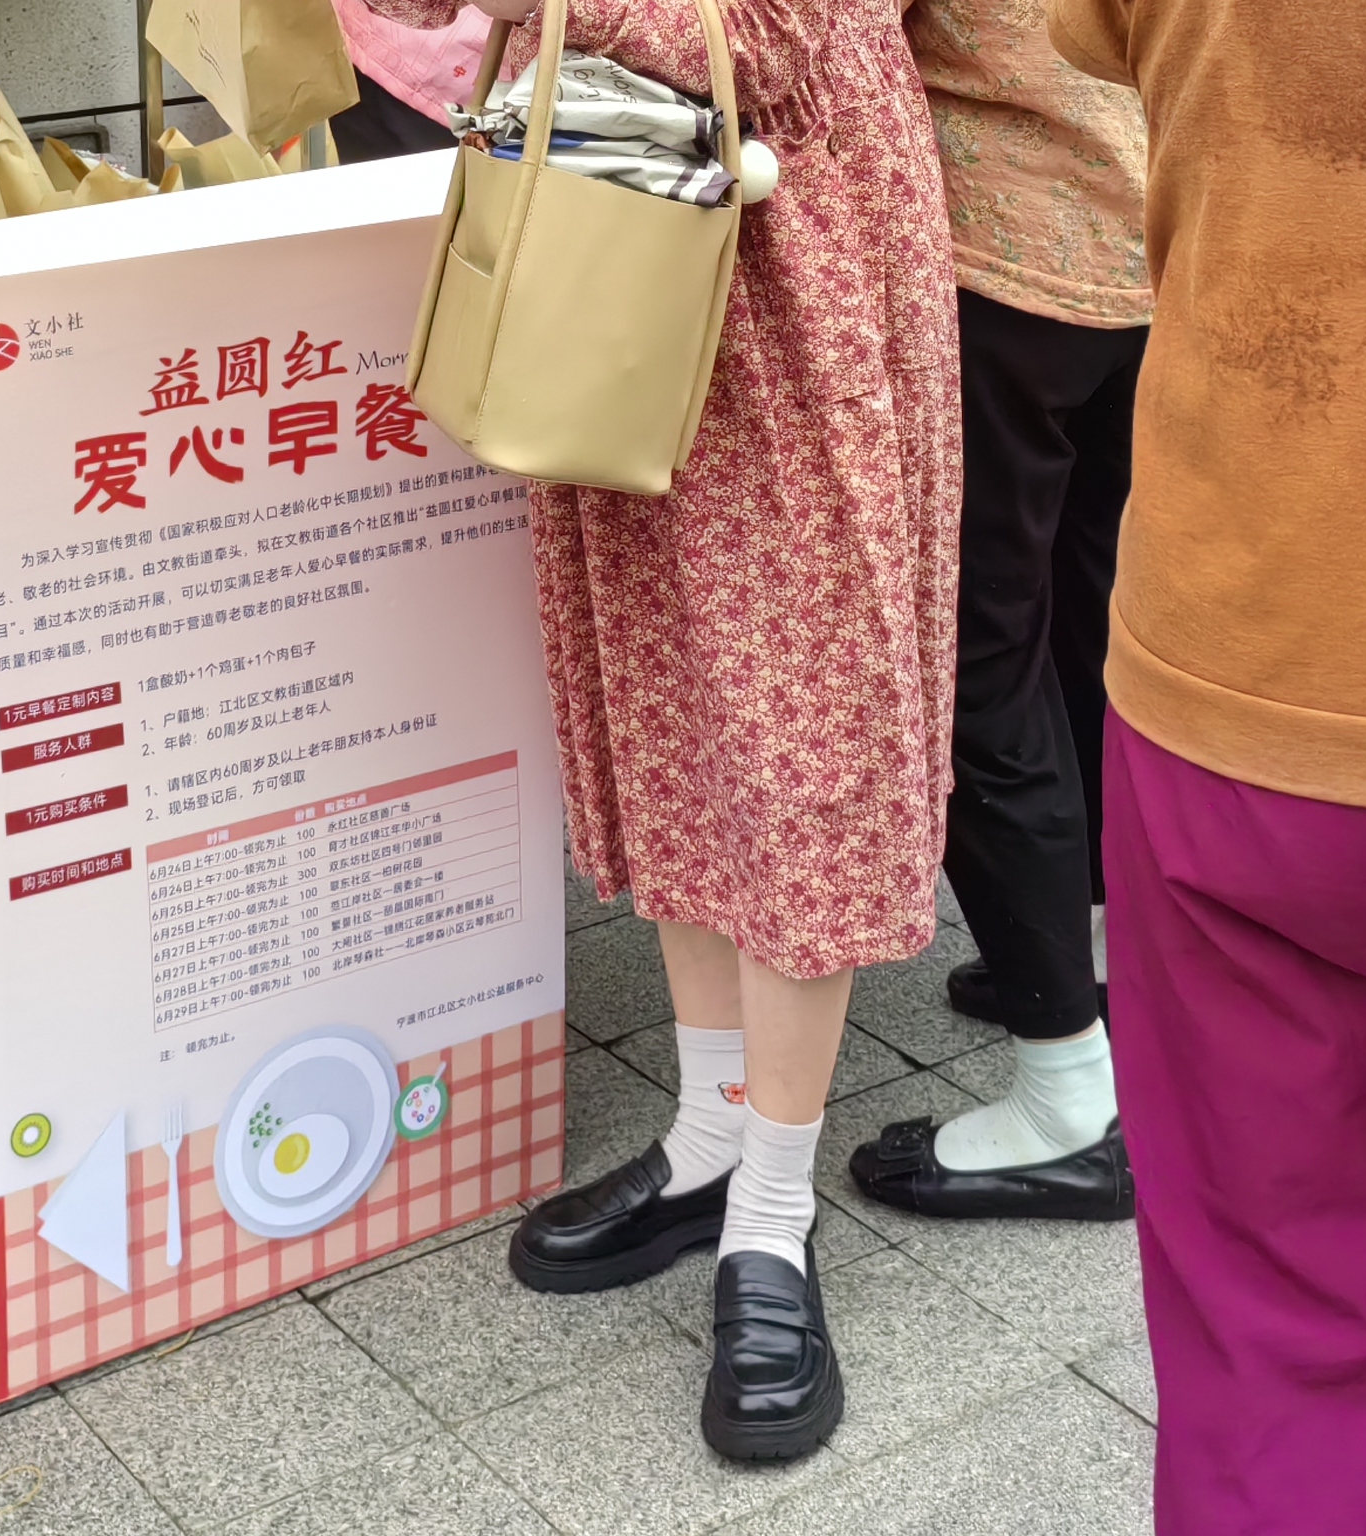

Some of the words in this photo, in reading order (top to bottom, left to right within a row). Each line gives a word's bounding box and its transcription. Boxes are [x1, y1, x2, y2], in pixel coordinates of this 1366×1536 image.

[24, 311, 84, 339] 文小社
[28, 339, 53, 351] WEN
[29, 349, 53, 362] XIAO
[55, 346, 74, 358] SHE
[138, 330, 348, 417] 益圆红
[74, 382, 428, 515] 爱心早餐
[137, 638, 316, 696] 1盒酸奶+1个鸡蛋+1个肉包子
[3, 683, 115, 726] 1元早餐定制内容
[32, 731, 92, 761] 服务人群
[25, 790, 108, 827] 1元购买条件
[295, 824, 316, 842] 100
[296, 844, 317, 862] 100
[21, 851, 123, 894] 购买时间和地点
[297, 864, 317, 882] 300
[298, 885, 318, 902] 100
[299, 904, 319, 922] 100
[300, 924, 320, 942] 100
[301, 943, 321, 962] 100
[302, 963, 322, 982] 100
